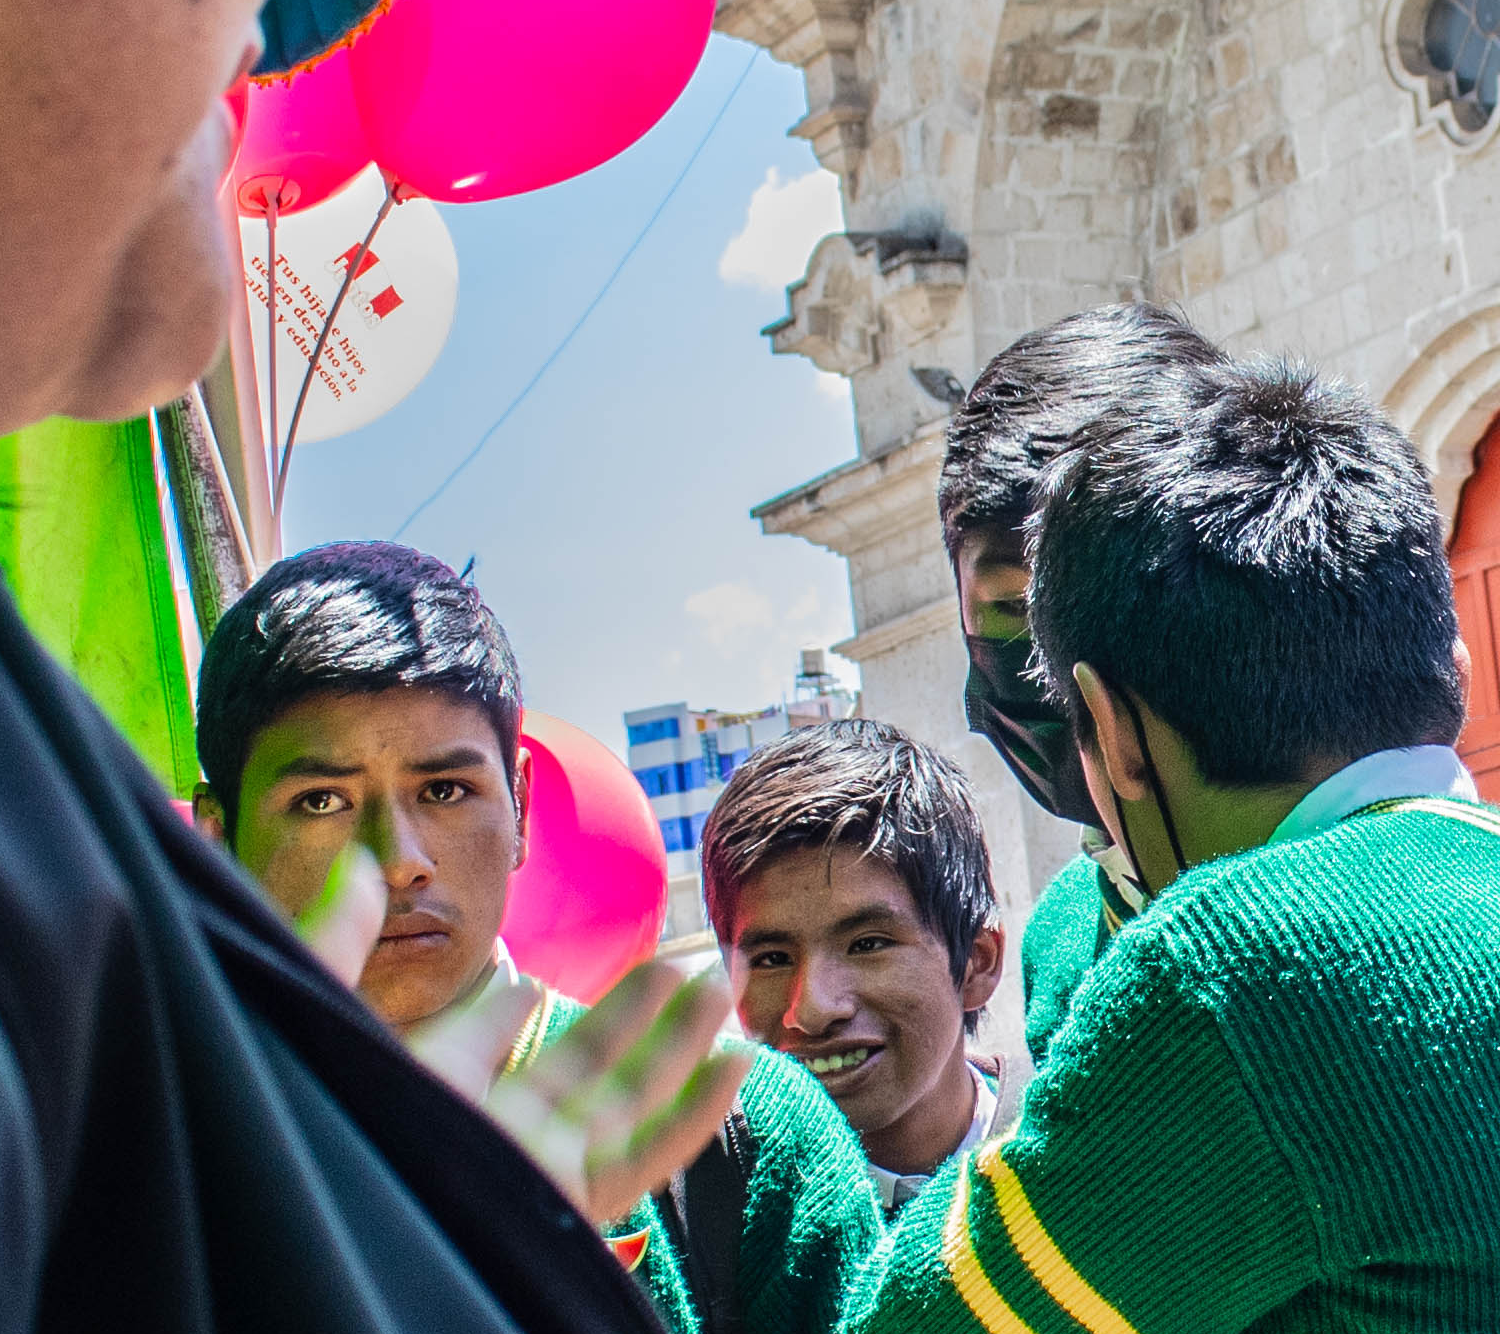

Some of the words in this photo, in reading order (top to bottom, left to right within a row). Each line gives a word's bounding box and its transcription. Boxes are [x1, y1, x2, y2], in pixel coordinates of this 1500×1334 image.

[250, 256, 294, 307] tieen
[293, 306, 342, 369] dereho
[339, 370, 348, 380] a
[347, 377, 358, 393] la
[274, 253, 301, 285] Tus
[331, 327, 341, 337] e
[339, 336, 367, 376] hijos
